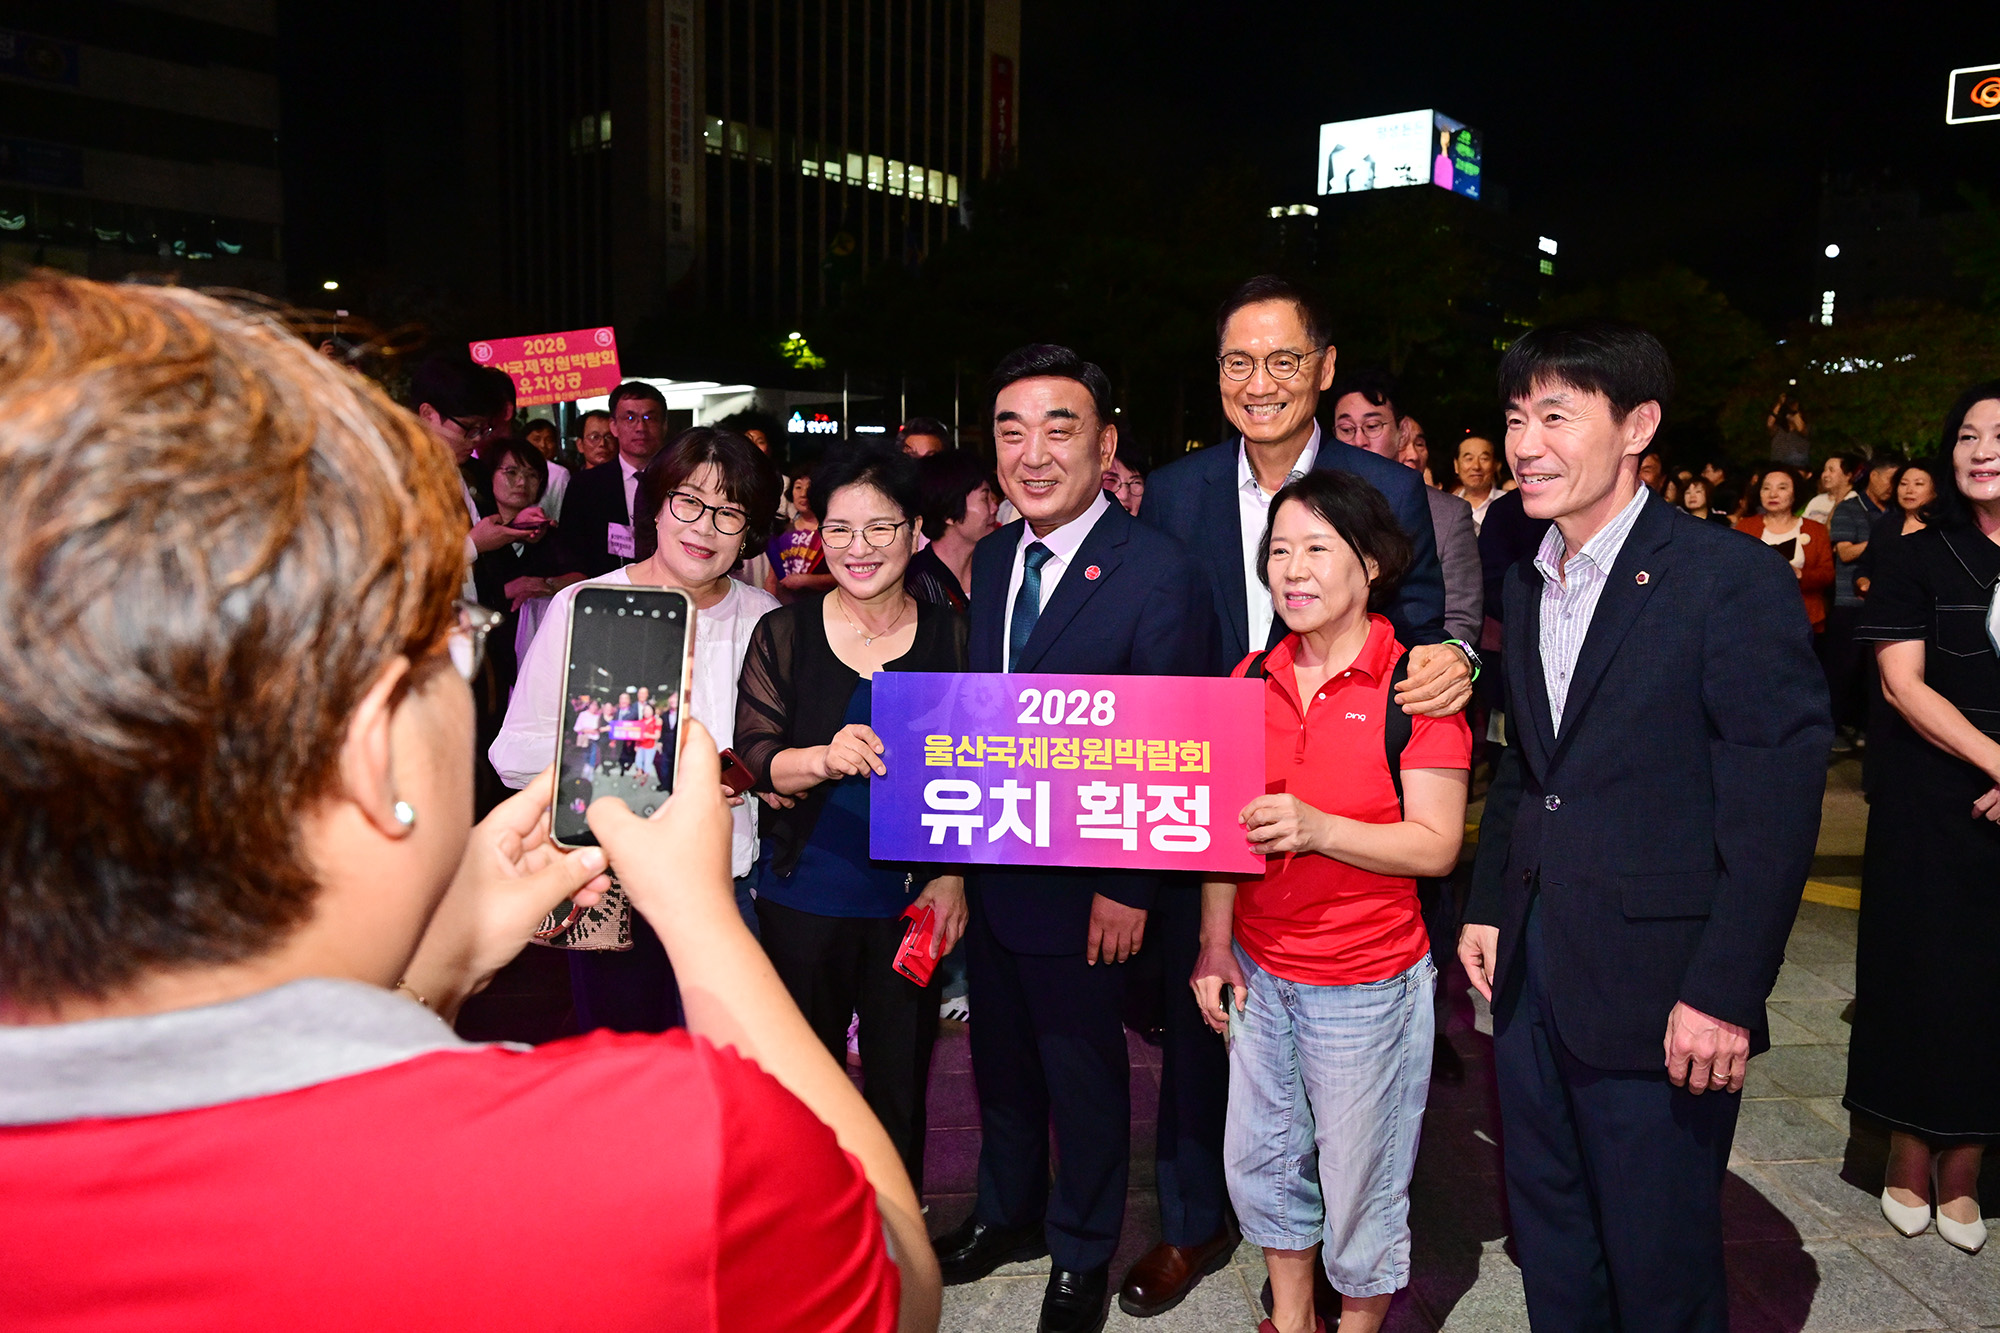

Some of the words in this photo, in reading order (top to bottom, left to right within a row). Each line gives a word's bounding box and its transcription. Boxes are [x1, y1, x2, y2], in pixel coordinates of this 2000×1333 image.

[523, 337, 567, 356] 2028
[483, 349, 616, 376] 산국제정원박람회
[519, 372, 582, 395] 유치성공
[1016, 688, 1116, 726] 2028
[1345, 712, 1366, 722] ping
[924, 734, 1211, 773] 울산국제정원박람회
[921, 779, 1050, 848] 유치
[1076, 780, 1211, 852] 확정
